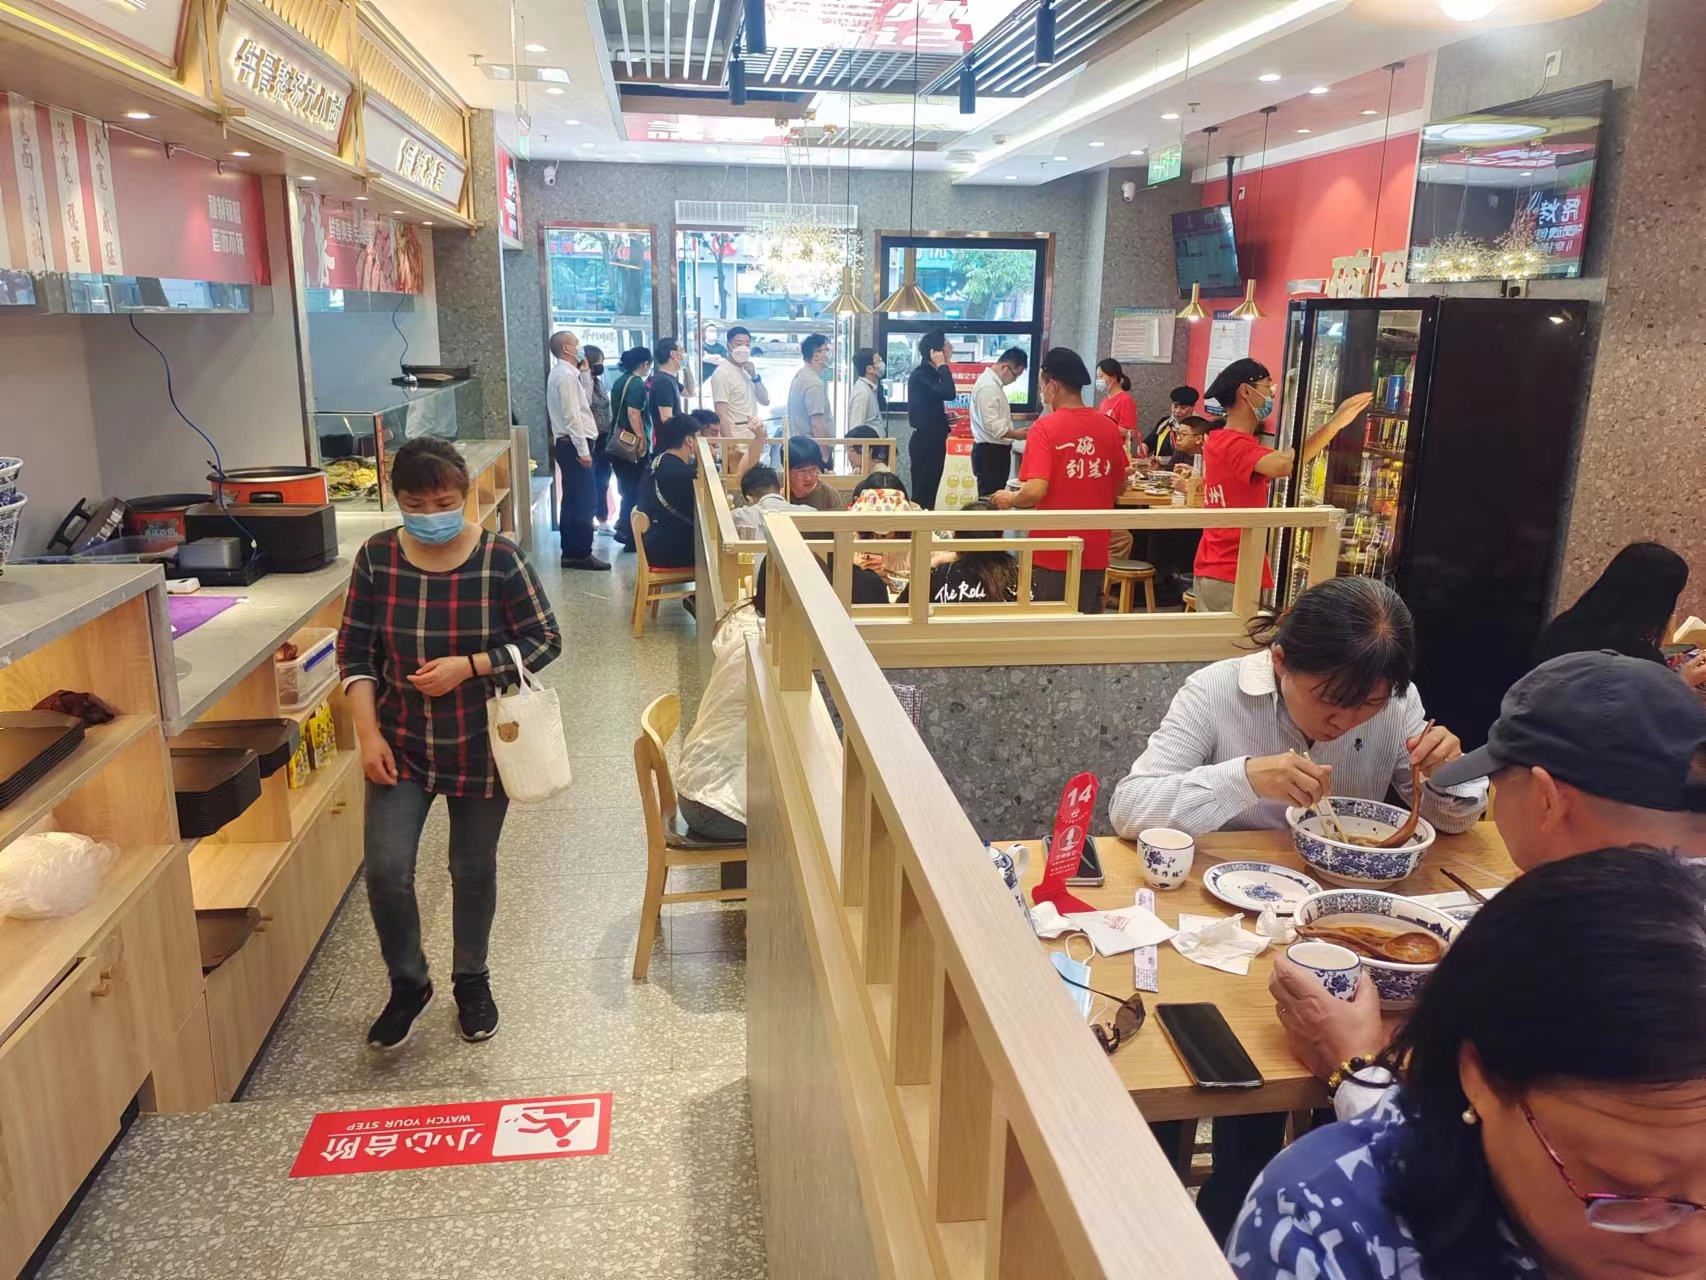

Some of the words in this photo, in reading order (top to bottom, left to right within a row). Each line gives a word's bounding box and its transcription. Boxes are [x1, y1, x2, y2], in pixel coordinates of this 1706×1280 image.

[1055, 435, 1096, 456] 一碗
[1203, 483, 1226, 508] 州
[934, 582, 958, 604] The
[1067, 783, 1093, 807] 14
[346, 1119, 381, 1132] STEP
[384, 1116, 421, 1129] YOUR
[425, 1113, 472, 1127] WATCH
[319, 1128, 482, 1162] 小心台阶
